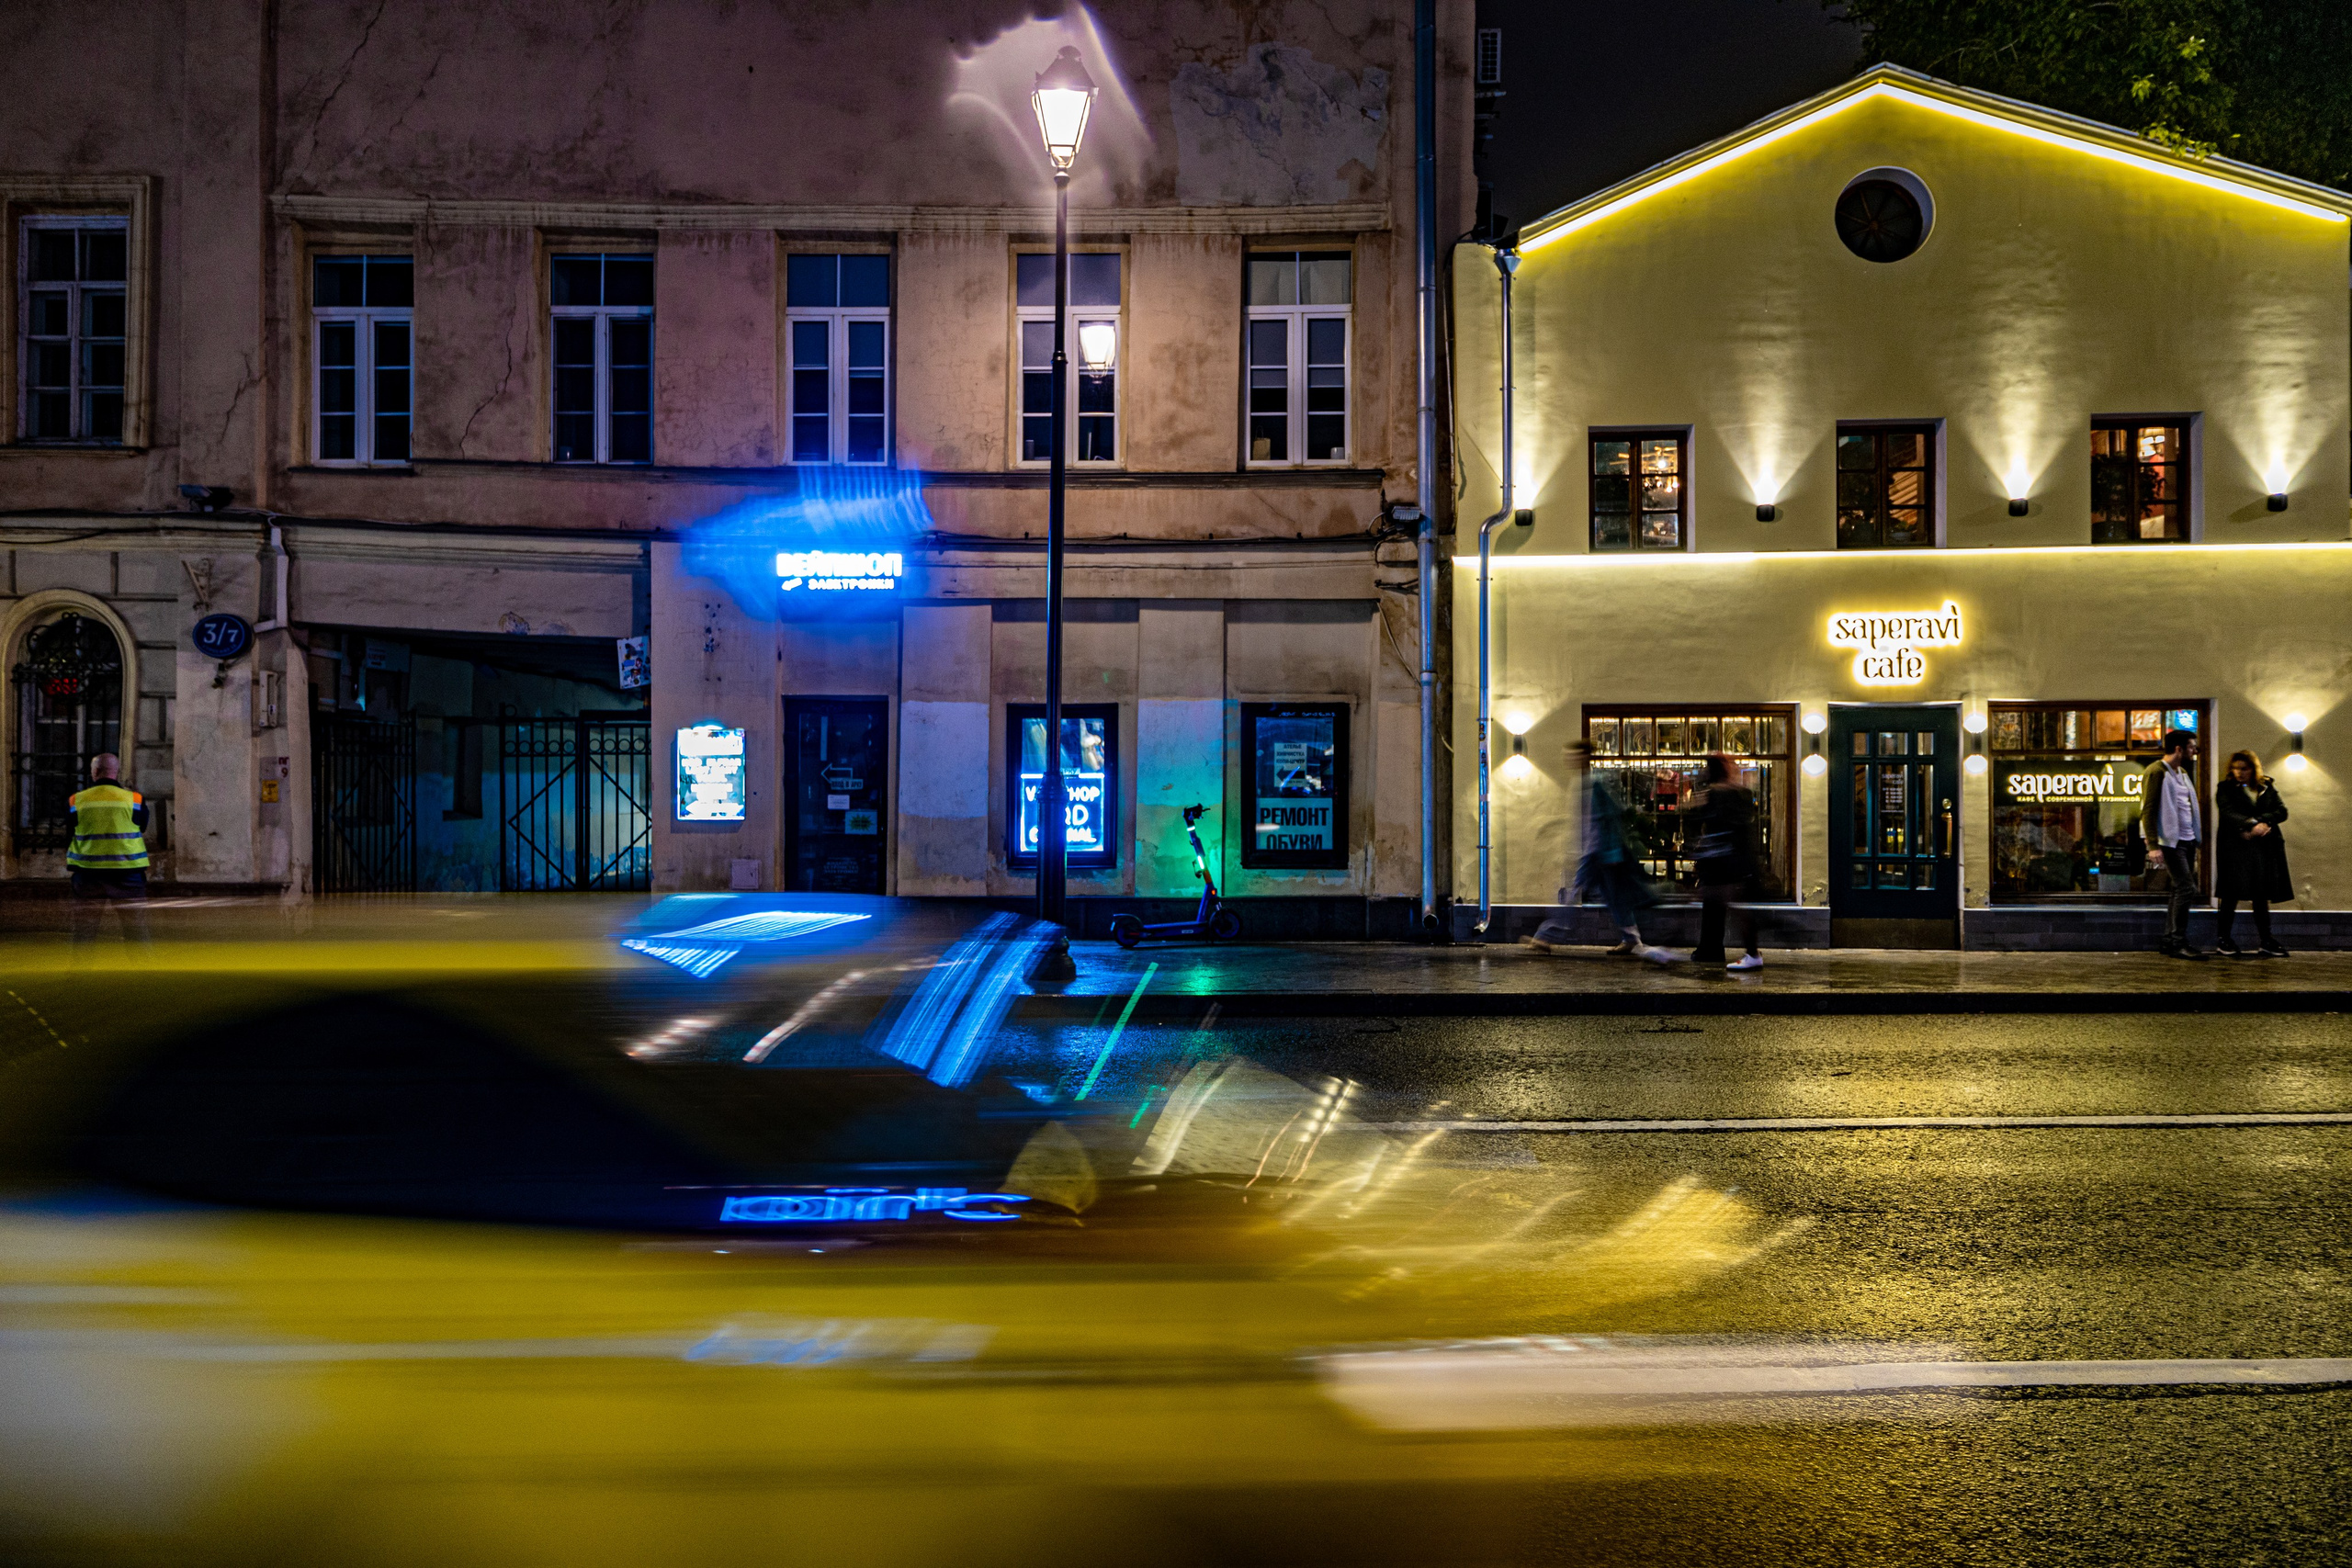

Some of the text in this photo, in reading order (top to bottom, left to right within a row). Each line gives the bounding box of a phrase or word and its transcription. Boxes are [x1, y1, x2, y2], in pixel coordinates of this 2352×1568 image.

[203, 621, 239, 646] 3/7
[1863, 648, 1922, 678] cafe
[1260, 807, 1329, 826] РЕМОНТ
[1266, 834, 1323, 850] ОБУВИ
